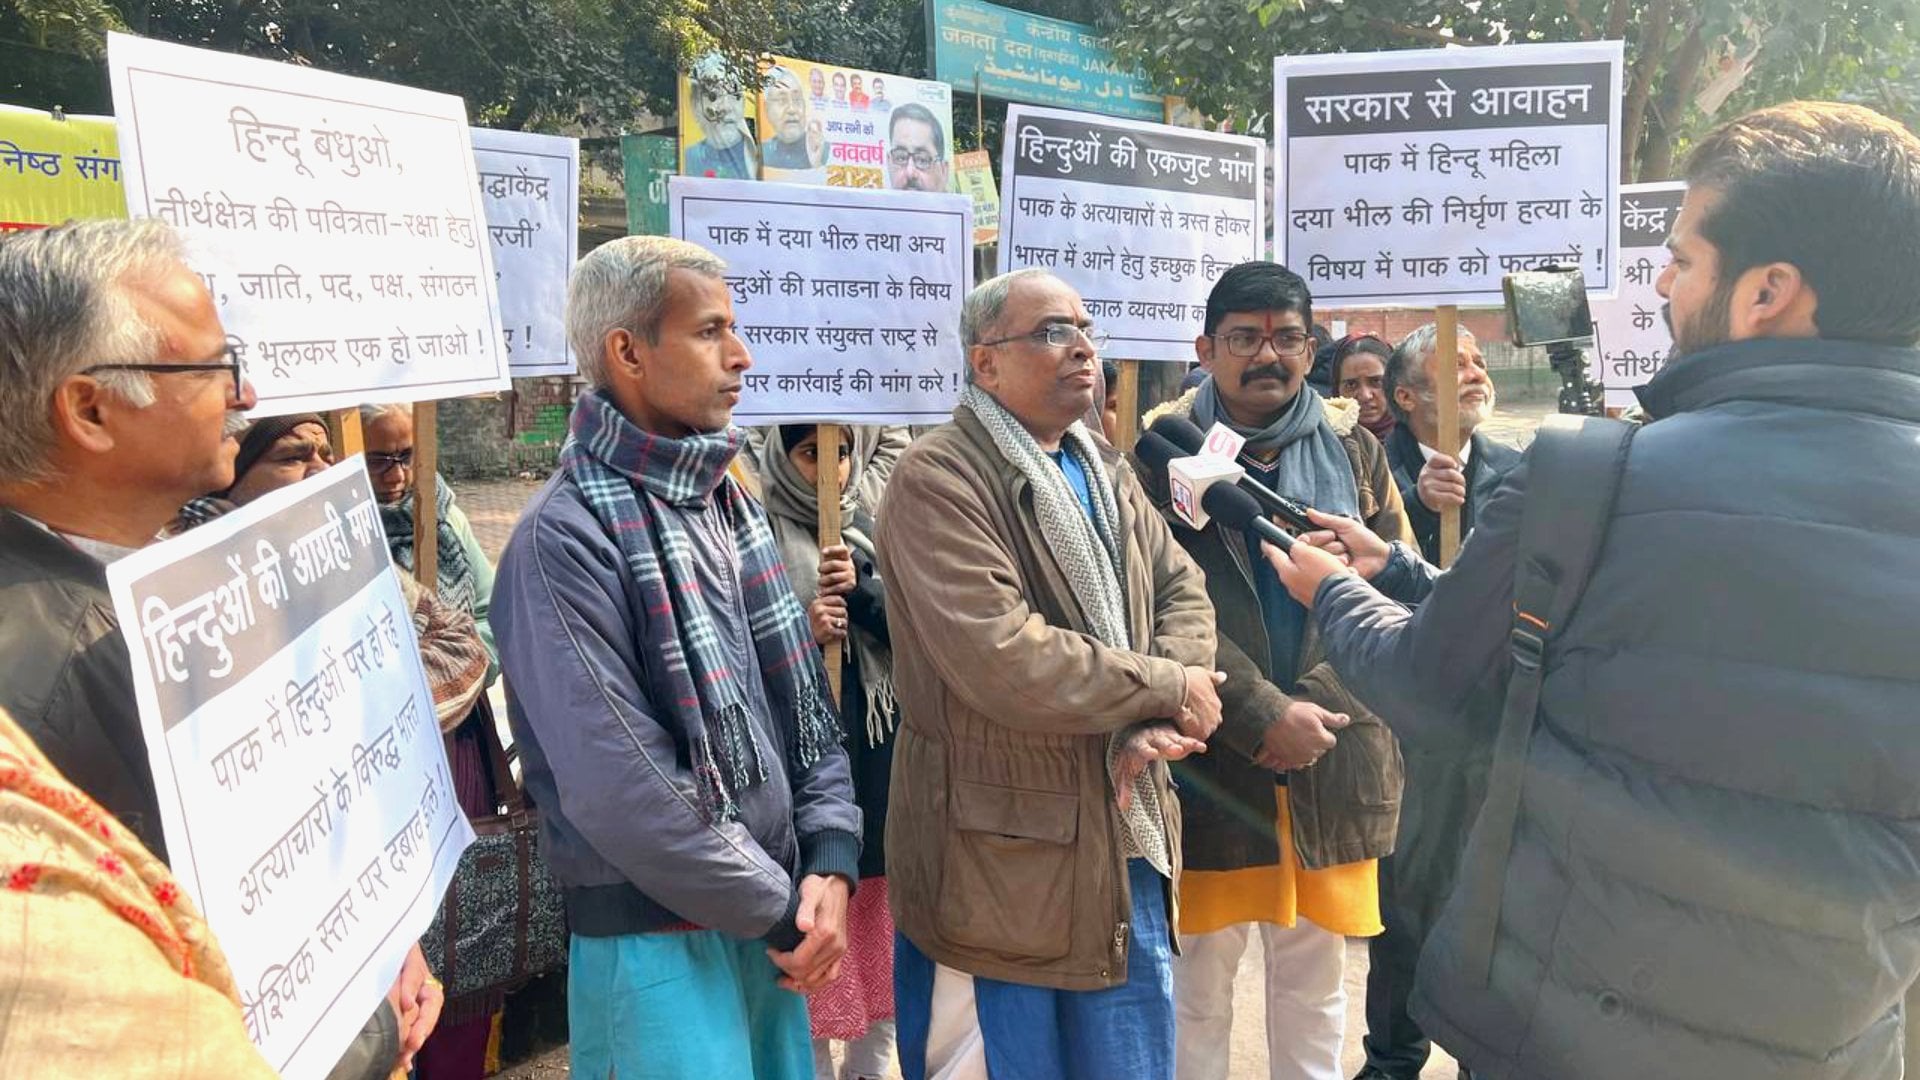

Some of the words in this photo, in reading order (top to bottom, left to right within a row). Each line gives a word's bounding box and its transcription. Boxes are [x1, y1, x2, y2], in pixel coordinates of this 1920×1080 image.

[940, 26, 997, 54] जनता
[1002, 39, 1032, 60] दल
[1082, 57, 1135, 80] JANA
[1305, 91, 1413, 125] सरकार
[1426, 78, 1456, 119] से
[1469, 83, 1592, 121] आवाहन
[228, 106, 315, 179] हिन्दू
[310, 118, 403, 178] बंधुओ,
[831, 140, 885, 165] नववर्ष
[1019, 125, 1101, 174] हिन्दुओं
[1110, 135, 1138, 169] की
[1146, 148, 1213, 186] एकजुट
[1219, 151, 1255, 184] मांग
[1344, 153, 1392, 174] पाक
[1401, 143, 1419, 172] में
[1428, 143, 1486, 179] हिन्दू
[1489, 139, 1562, 171] महिला
[154, 187, 257, 230] तीर्थक्षेत्र
[265, 196, 298, 232] की
[305, 200, 440, 238] पवित्रता-रक्षा
[444, 208, 477, 248] हेतु
[1018, 197, 1056, 217] पाक
[1060, 193, 1077, 219] के
[1081, 201, 1155, 228] अत्याचारों
[1160, 203, 1174, 229] से
[1178, 212, 1210, 233] त्रस्त
[1214, 210, 1251, 237] होकर
[1292, 207, 1334, 232] दया
[1344, 200, 1392, 228] भील
[1403, 198, 1433, 225] की
[1443, 196, 1507, 230] निर्घृण
[1517, 198, 1571, 225] हत्या
[1580, 190, 1604, 219] के
[1622, 200, 1668, 233] केंद्र
[708, 225, 749, 247] पाक
[756, 220, 771, 248] में
[778, 227, 812, 249] दया
[819, 224, 859, 251] भील
[866, 232, 902, 254] तथा
[908, 235, 946, 255] अन्य
[1015, 245, 1059, 268] भारत
[1063, 242, 1078, 269] में
[1082, 245, 1115, 271] आने
[1120, 247, 1145, 280] हेतु
[1150, 255, 1196, 282] इच्छुक
[1308, 255, 1366, 282] विषय
[1374, 252, 1394, 279] में
[1403, 256, 1448, 278] पाक
[1459, 248, 1490, 277] को
[1595, 248, 1603, 272] !
[238, 264, 312, 303] जाति,
[319, 273, 362, 303] पद,
[370, 273, 413, 301] पक्ष,
[419, 266, 479, 298] संगठन
[723, 270, 771, 303] न्दुओं
[780, 271, 804, 297] की
[811, 279, 880, 300] प्रताडना
[886, 274, 904, 301] के
[910, 276, 952, 301] विषय
[1127, 299, 1187, 322] व्यवस्था
[1631, 304, 1656, 331] के
[258, 338, 339, 378] भूलकर
[344, 335, 381, 367] एक
[389, 326, 410, 364] हो
[416, 324, 468, 358] जाओ
[476, 328, 484, 355] !
[744, 325, 808, 346] सरकार
[816, 320, 875, 352] संयुक्त
[881, 326, 917, 352] राष्ट्र
[921, 321, 938, 347] से
[745, 373, 770, 393] पर
[777, 368, 843, 396] कार्रवाई
[850, 368, 874, 393] की
[880, 369, 912, 393] मांग
[918, 368, 944, 393] करे
[952, 373, 958, 393] !
[141, 552, 257, 684] हिन्दुओं
[251, 538, 289, 610] की
[288, 500, 352, 587] आग्रही
[345, 488, 381, 547] मांग
[211, 727, 263, 793] पाक
[265, 695, 287, 748] में
[285, 646, 345, 736] हिन्दुओं
[342, 639, 371, 679] पर
[366, 614, 384, 669] हो
[239, 779, 333, 916] अत्याचारों
[330, 767, 351, 814] के
[352, 725, 402, 797] विरुद्ध
[394, 693, 419, 744] भारत
[316, 888, 360, 953] स्तर
[357, 856, 389, 901] पर
[384, 810, 424, 874] दबाव
